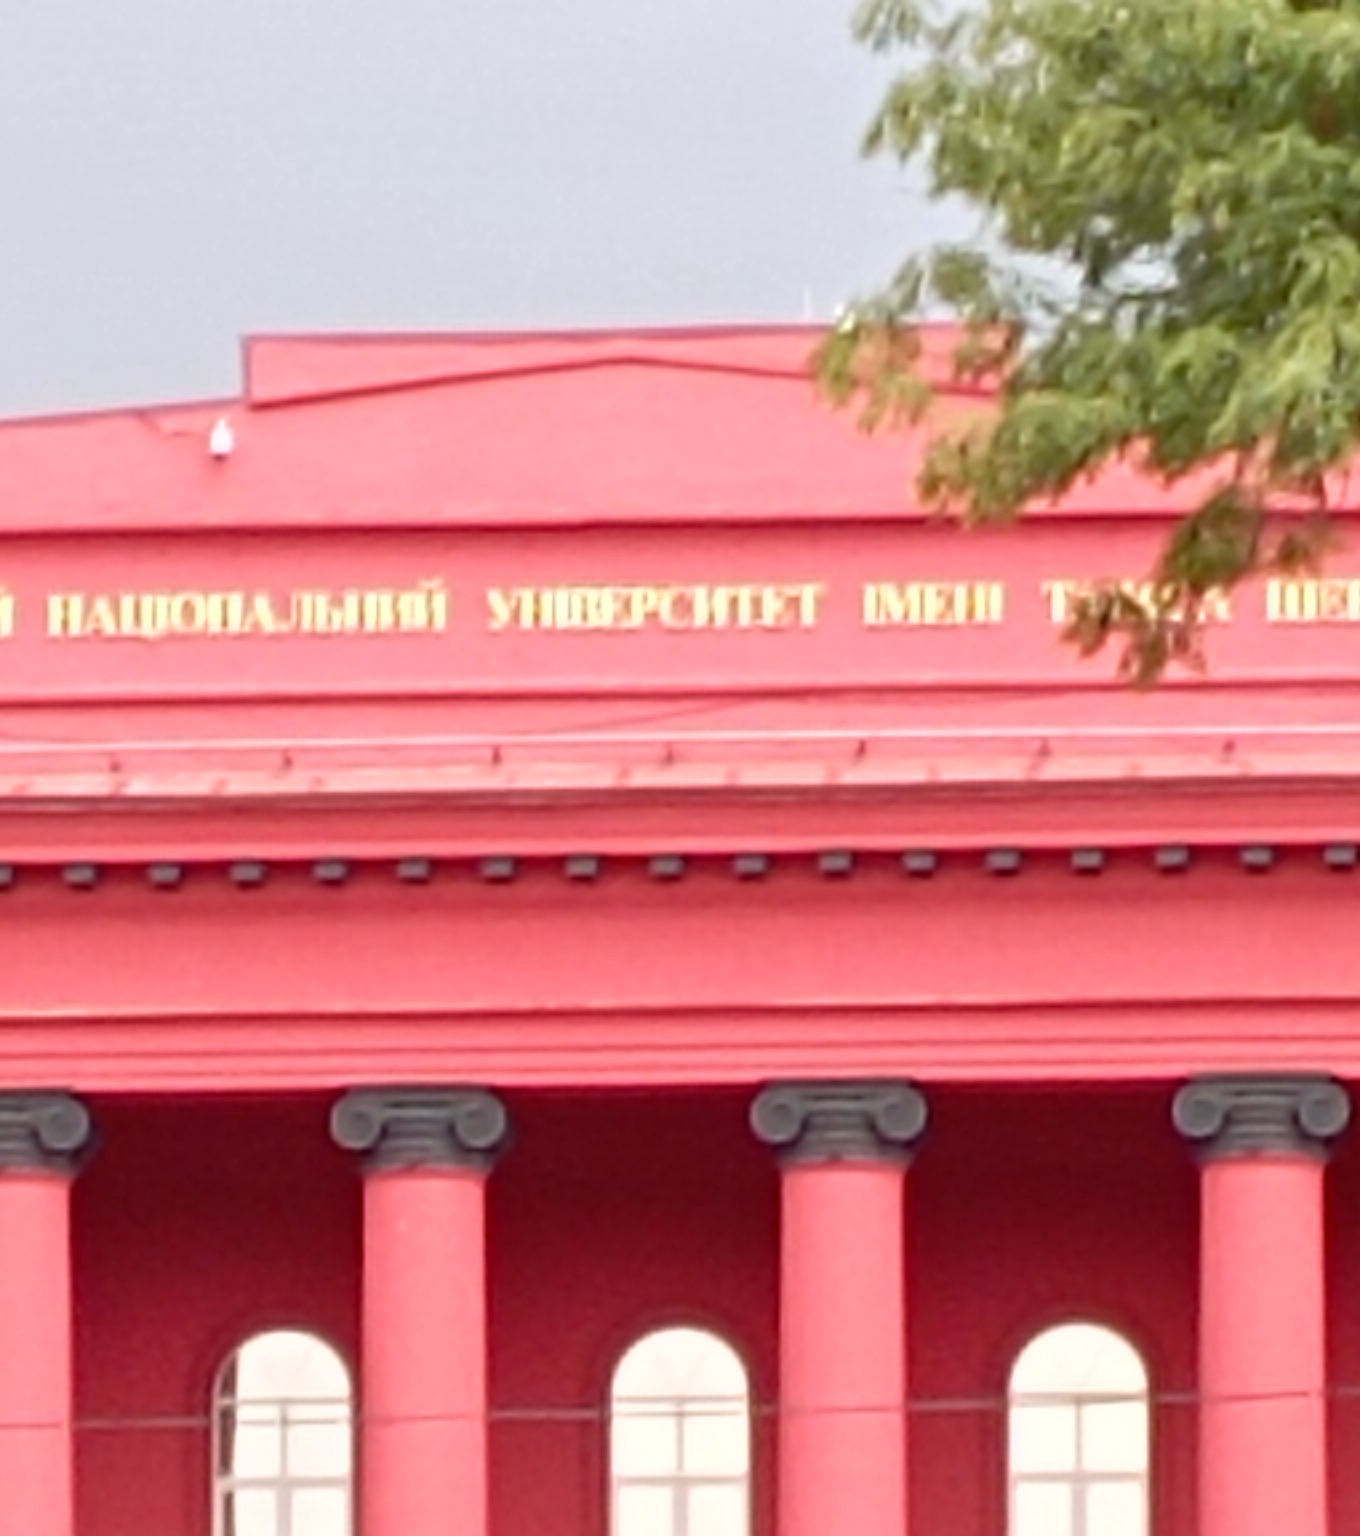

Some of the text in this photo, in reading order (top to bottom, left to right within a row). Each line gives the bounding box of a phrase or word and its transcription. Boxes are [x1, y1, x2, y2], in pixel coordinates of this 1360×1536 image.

[46, 577, 447, 638] НАЦІОНАЛЬНИЙ
[486, 582, 825, 630] УНІВЕРСИТЕТ
[862, 580, 1004, 626] ІМЕНІ
